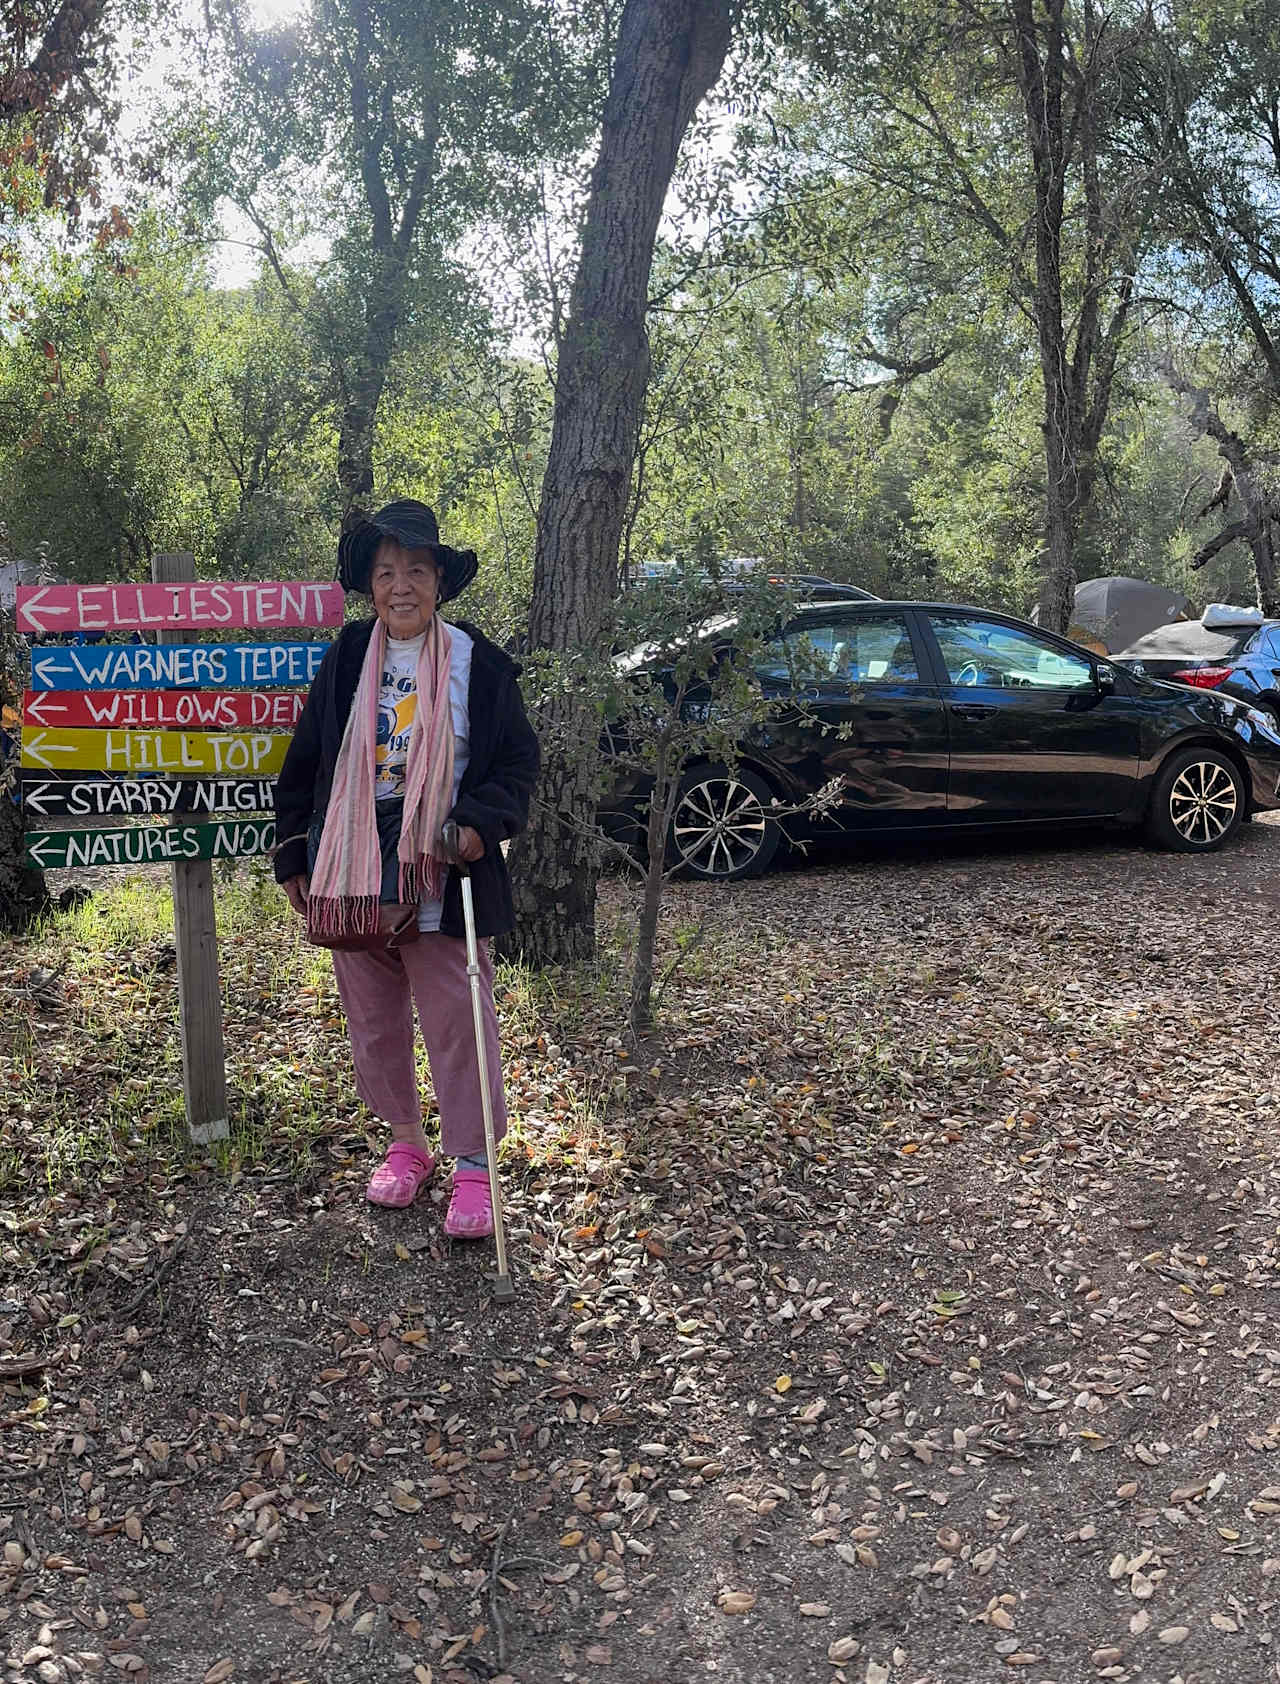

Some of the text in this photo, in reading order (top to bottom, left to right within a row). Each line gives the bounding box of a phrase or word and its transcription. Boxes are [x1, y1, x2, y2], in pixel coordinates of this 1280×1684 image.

[77, 584, 332, 627] ELLIESTENT
[70, 646, 323, 685] WARNERS TEPEE
[84, 693, 238, 725] WILLOWS
[66, 781, 182, 815] STARRY
[65, 822, 277, 867] NATURES NOO
